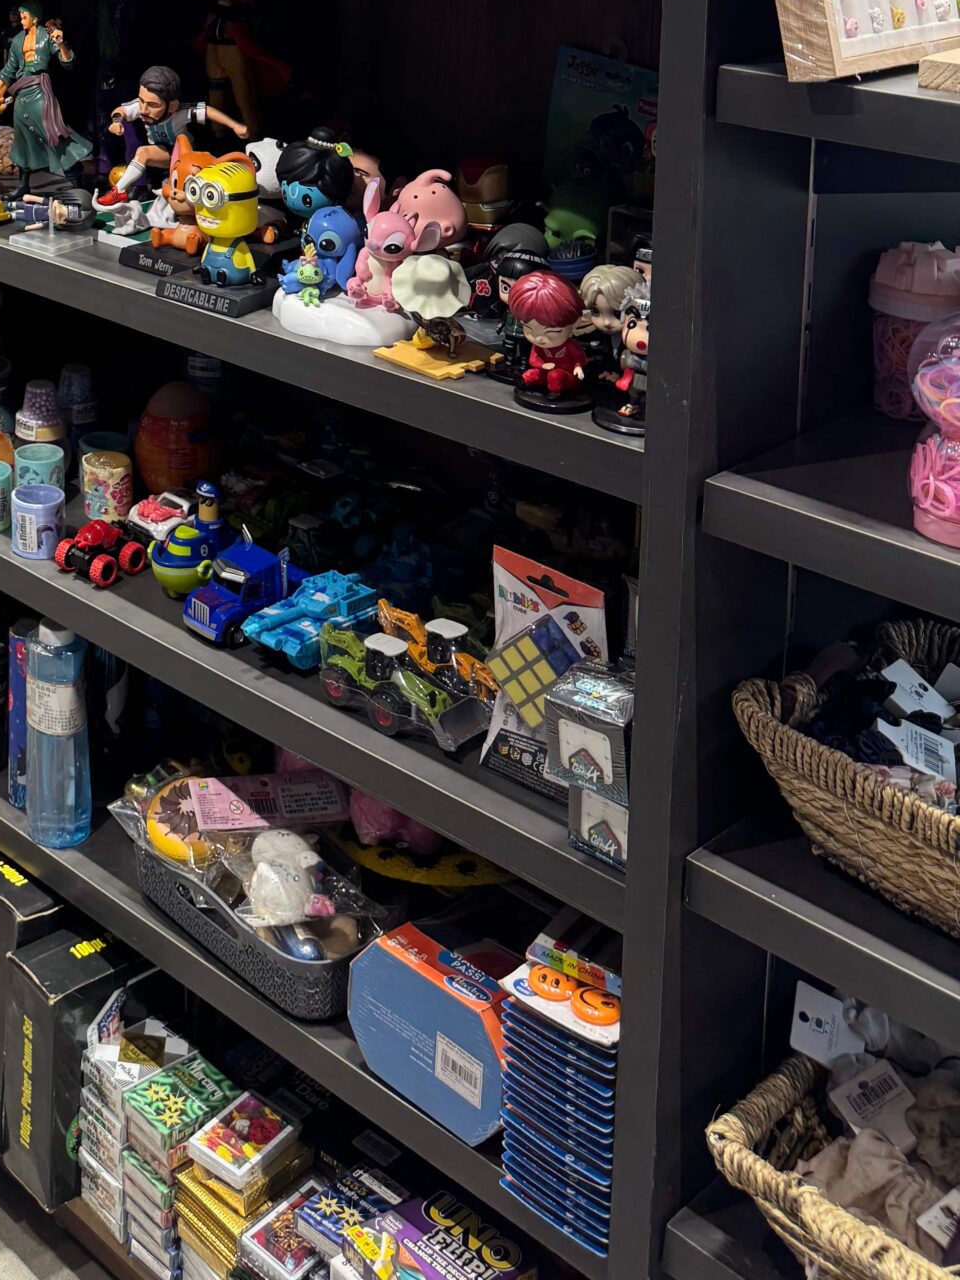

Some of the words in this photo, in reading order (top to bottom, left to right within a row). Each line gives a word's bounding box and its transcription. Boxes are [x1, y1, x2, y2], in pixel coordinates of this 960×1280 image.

[139, 254, 152, 267] Tom
[155, 259, 173, 275] Jerry
[164, 282, 214, 309] DESPICABLE
[216, 297, 230, 312] ME
[70, 937, 106, 960] 100pc
[541, 951, 565, 966] MADE
[566, 960, 578, 970] IN
[578, 967, 606, 982] CHINA
[23, 1014, 34, 1039] Set
[22, 1038, 33, 1074] Game
[21, 1072, 33, 1112] Poker
[186, 1061, 226, 1100] Mercury
[19, 1115, 33, 1150] 100pc
[422, 1190, 522, 1274] UNO
[403, 1238, 432, 1265] CHANGE
[426, 1226, 501, 1280] FLIP!
